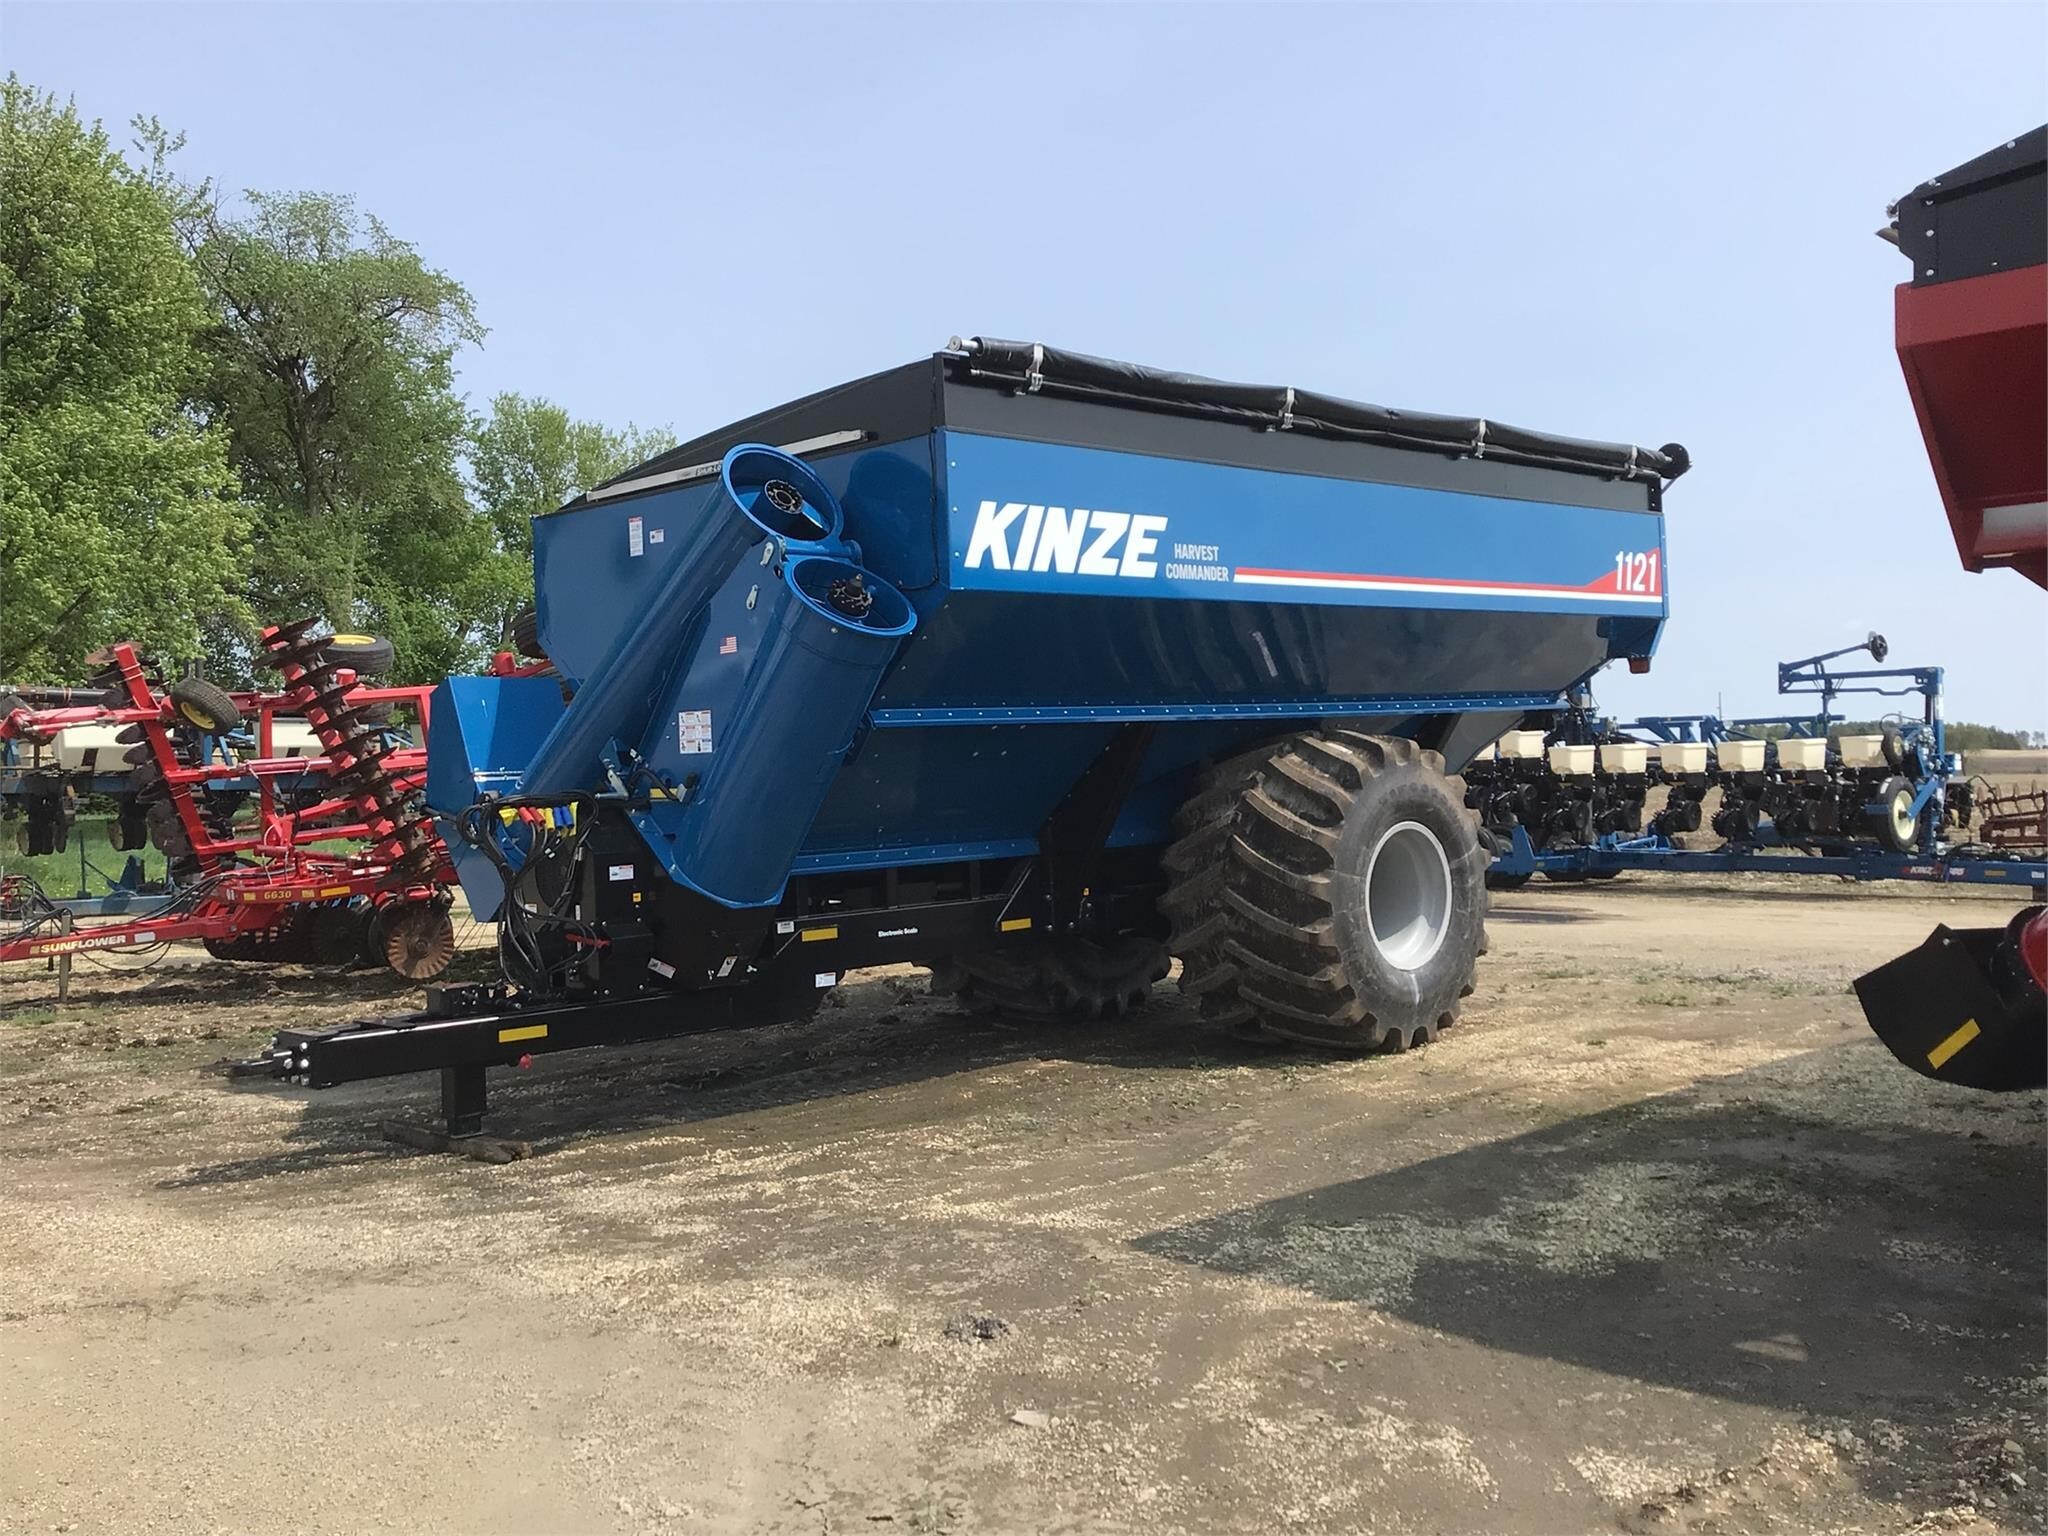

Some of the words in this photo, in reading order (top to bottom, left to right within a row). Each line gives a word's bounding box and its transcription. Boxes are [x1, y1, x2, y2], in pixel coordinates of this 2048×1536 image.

[964, 500, 1168, 578] KINZE
[1174, 543, 1220, 561] HARVEST
[1165, 563, 1230, 582] COMMANDER
[1615, 550, 1657, 592] 1121
[878, 929, 903, 938] Electronic
[40, 934, 127, 953] SUNFLOWER
